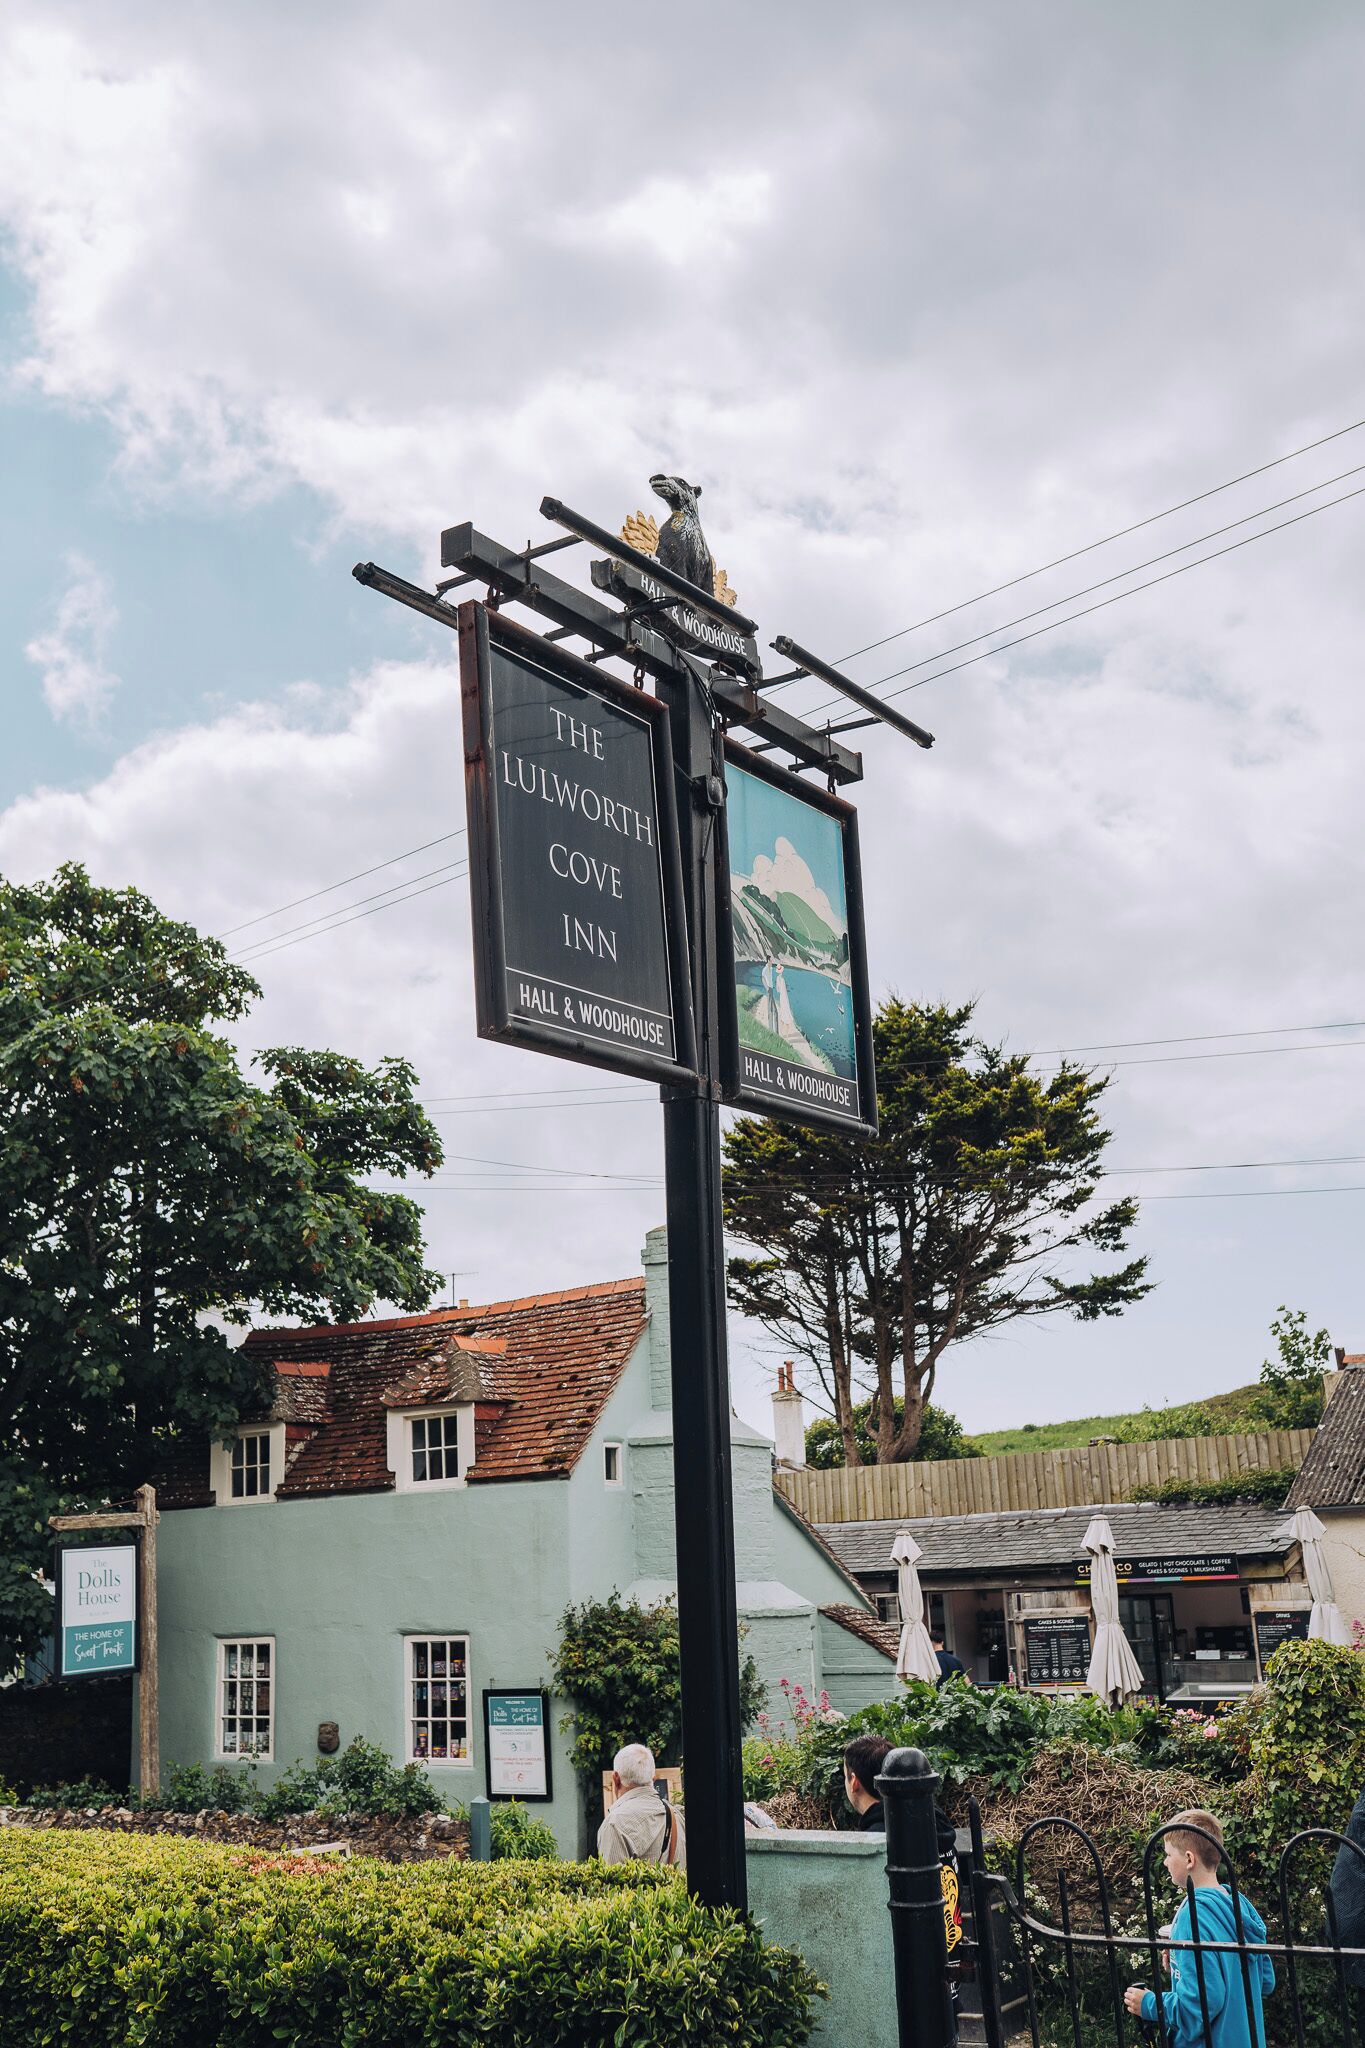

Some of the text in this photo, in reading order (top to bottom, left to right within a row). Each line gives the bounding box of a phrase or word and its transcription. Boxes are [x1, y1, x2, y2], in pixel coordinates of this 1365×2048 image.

[671, 605, 681, 626] &
[682, 608, 748, 656] WOODHOUSE
[550, 706, 605, 761] THE
[502, 750, 654, 847] LULWORTH
[549, 843, 623, 899] COVE
[562, 913, 618, 963] INN
[519, 983, 665, 1046] HALL & WOODHOUSE
[744, 1056, 851, 1107] HALL & WOODHOUSE
[78, 1569, 121, 1590] Dolls
[92, 1559, 108, 1568] The
[1077, 1562, 1133, 1574] CHCO
[1193, 1565, 1225, 1573] MILKSHAKES
[78, 1591, 121, 1606] House
[74, 1628, 125, 1641] THE HOME OF
[74, 1641, 125, 1662] Sweet Treats
